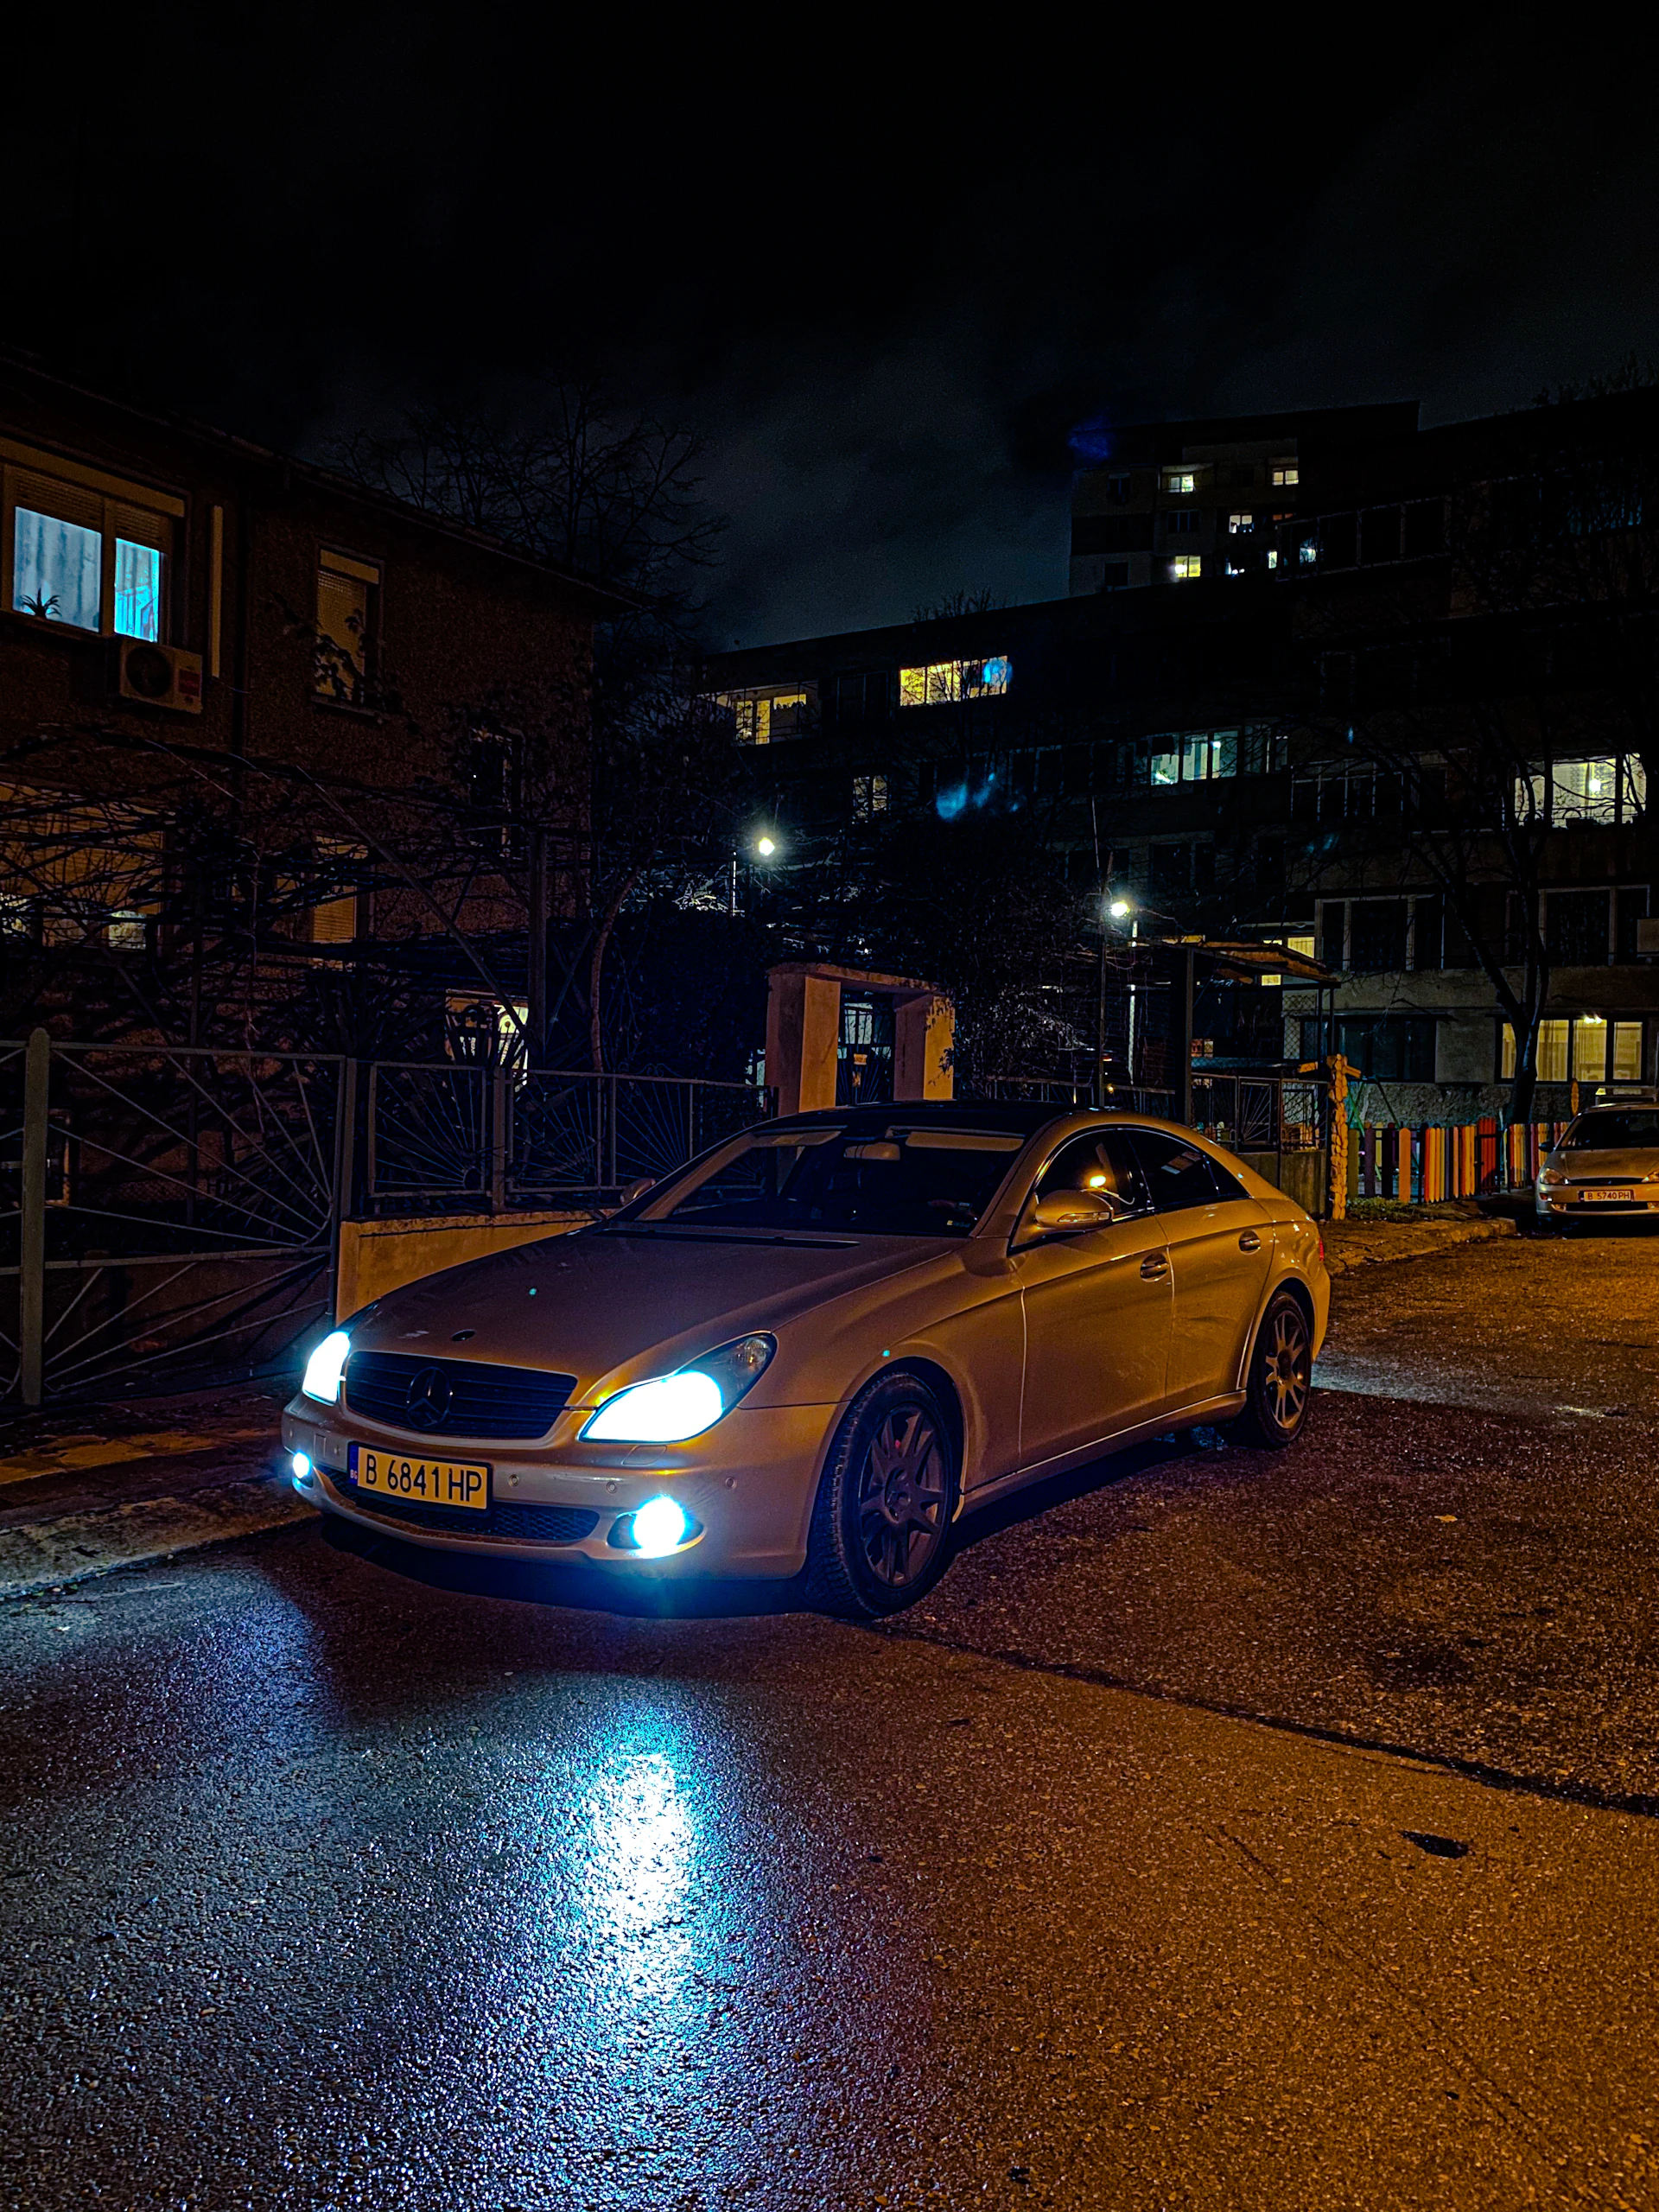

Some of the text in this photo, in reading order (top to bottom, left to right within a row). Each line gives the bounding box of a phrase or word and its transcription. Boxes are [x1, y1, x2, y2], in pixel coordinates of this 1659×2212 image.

[366, 1454, 482, 1502] B 6841 HP
